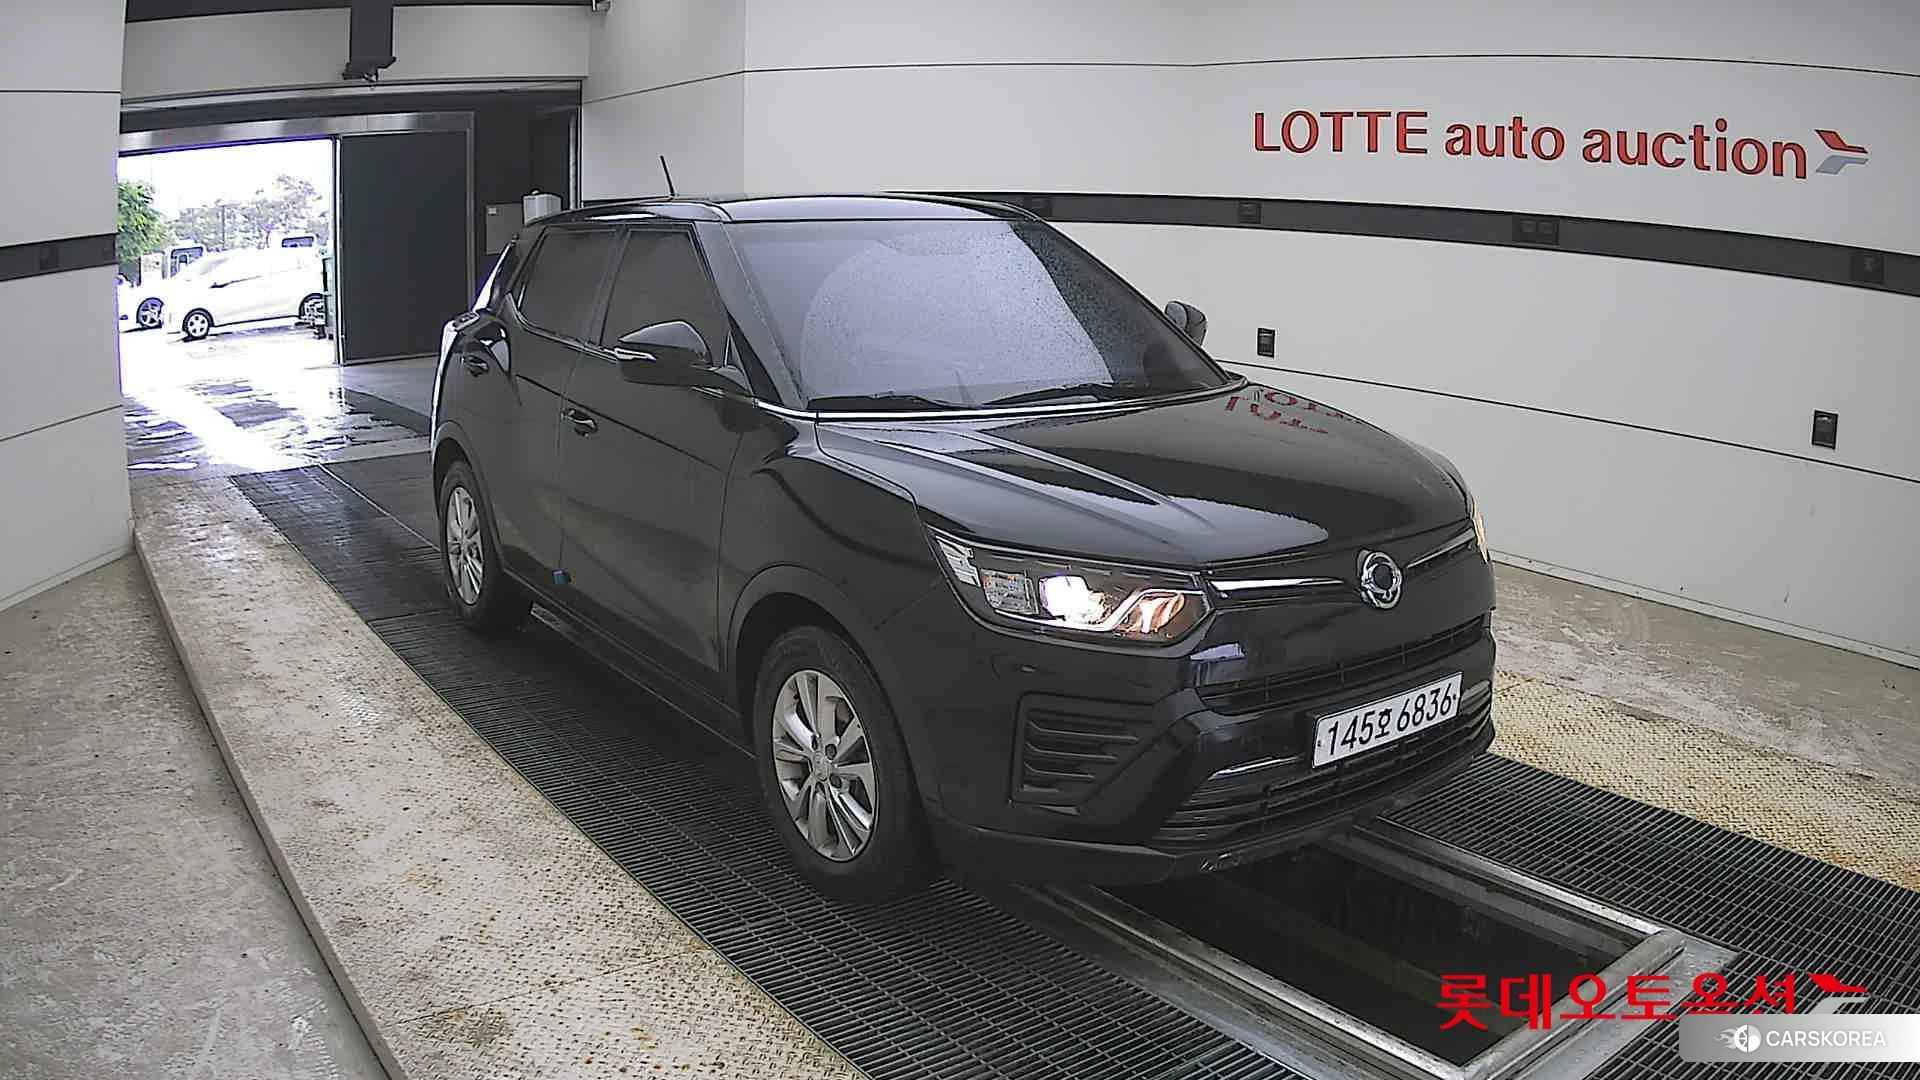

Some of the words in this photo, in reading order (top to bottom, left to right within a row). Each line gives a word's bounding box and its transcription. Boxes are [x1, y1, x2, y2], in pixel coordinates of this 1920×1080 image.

[1254, 111, 1429, 154] LOTTE
[1445, 116, 1566, 161] auto
[1582, 118, 1808, 179] auction
[1396, 683, 1453, 732] 6836
